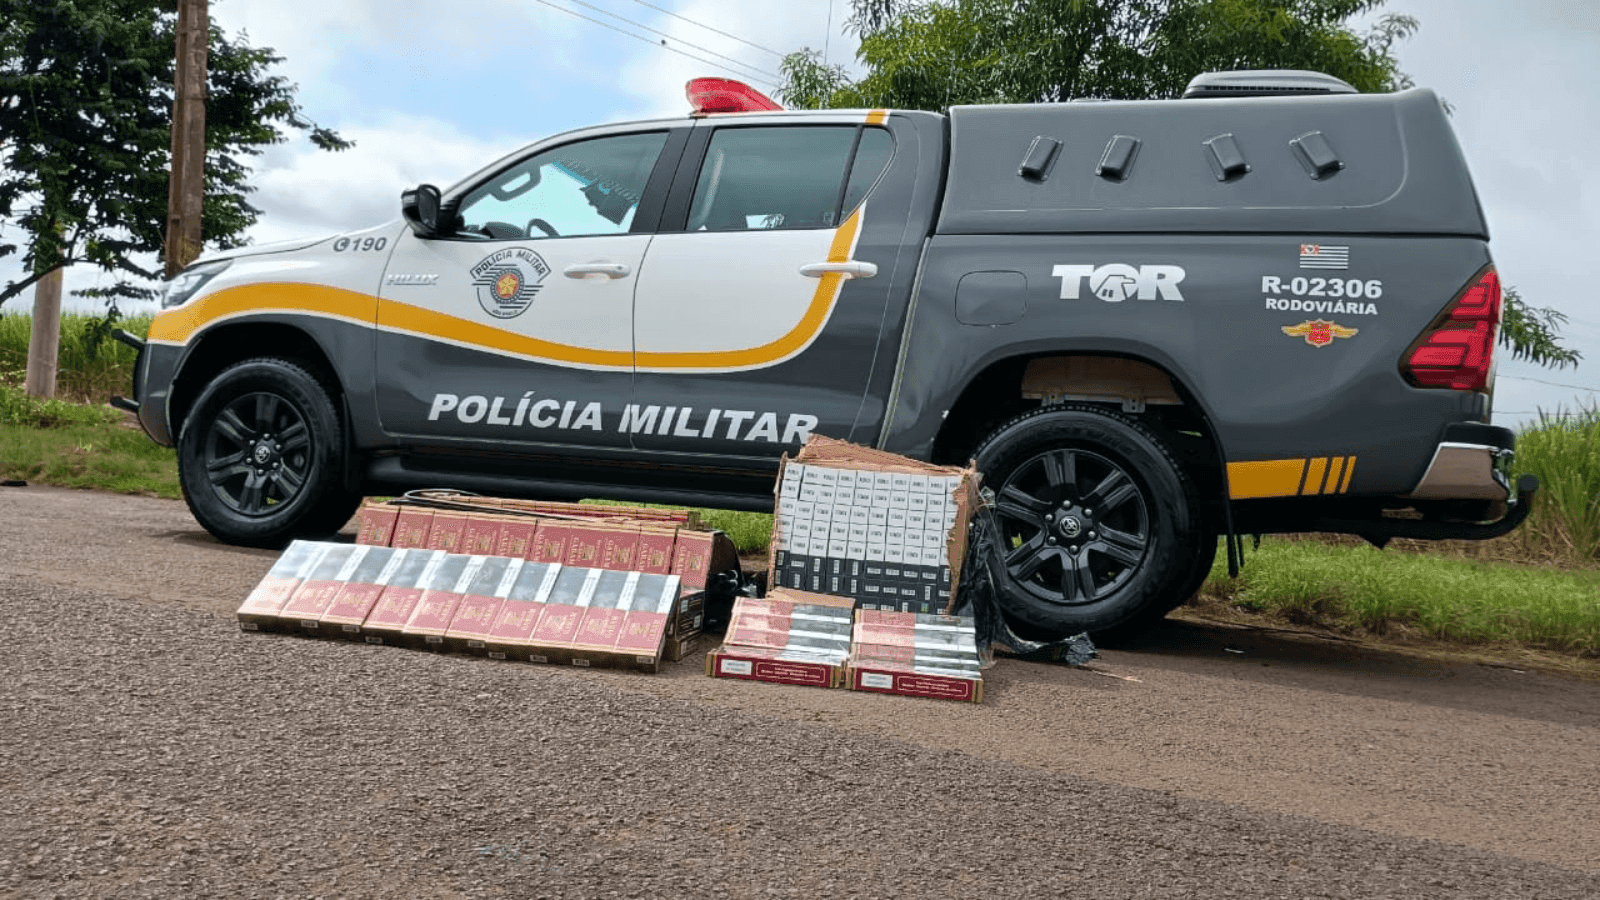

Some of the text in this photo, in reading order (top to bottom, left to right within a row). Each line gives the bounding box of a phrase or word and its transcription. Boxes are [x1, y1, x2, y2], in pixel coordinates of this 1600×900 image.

[352, 236, 388, 252] 190
[516, 250, 547, 277] MILITAR
[1052, 263, 1186, 302] TOR
[1261, 275, 1383, 299] R-02306
[1265, 298, 1378, 315] RODOVIÁRIA
[427, 390, 819, 445] POLÍCIA MILITAR
